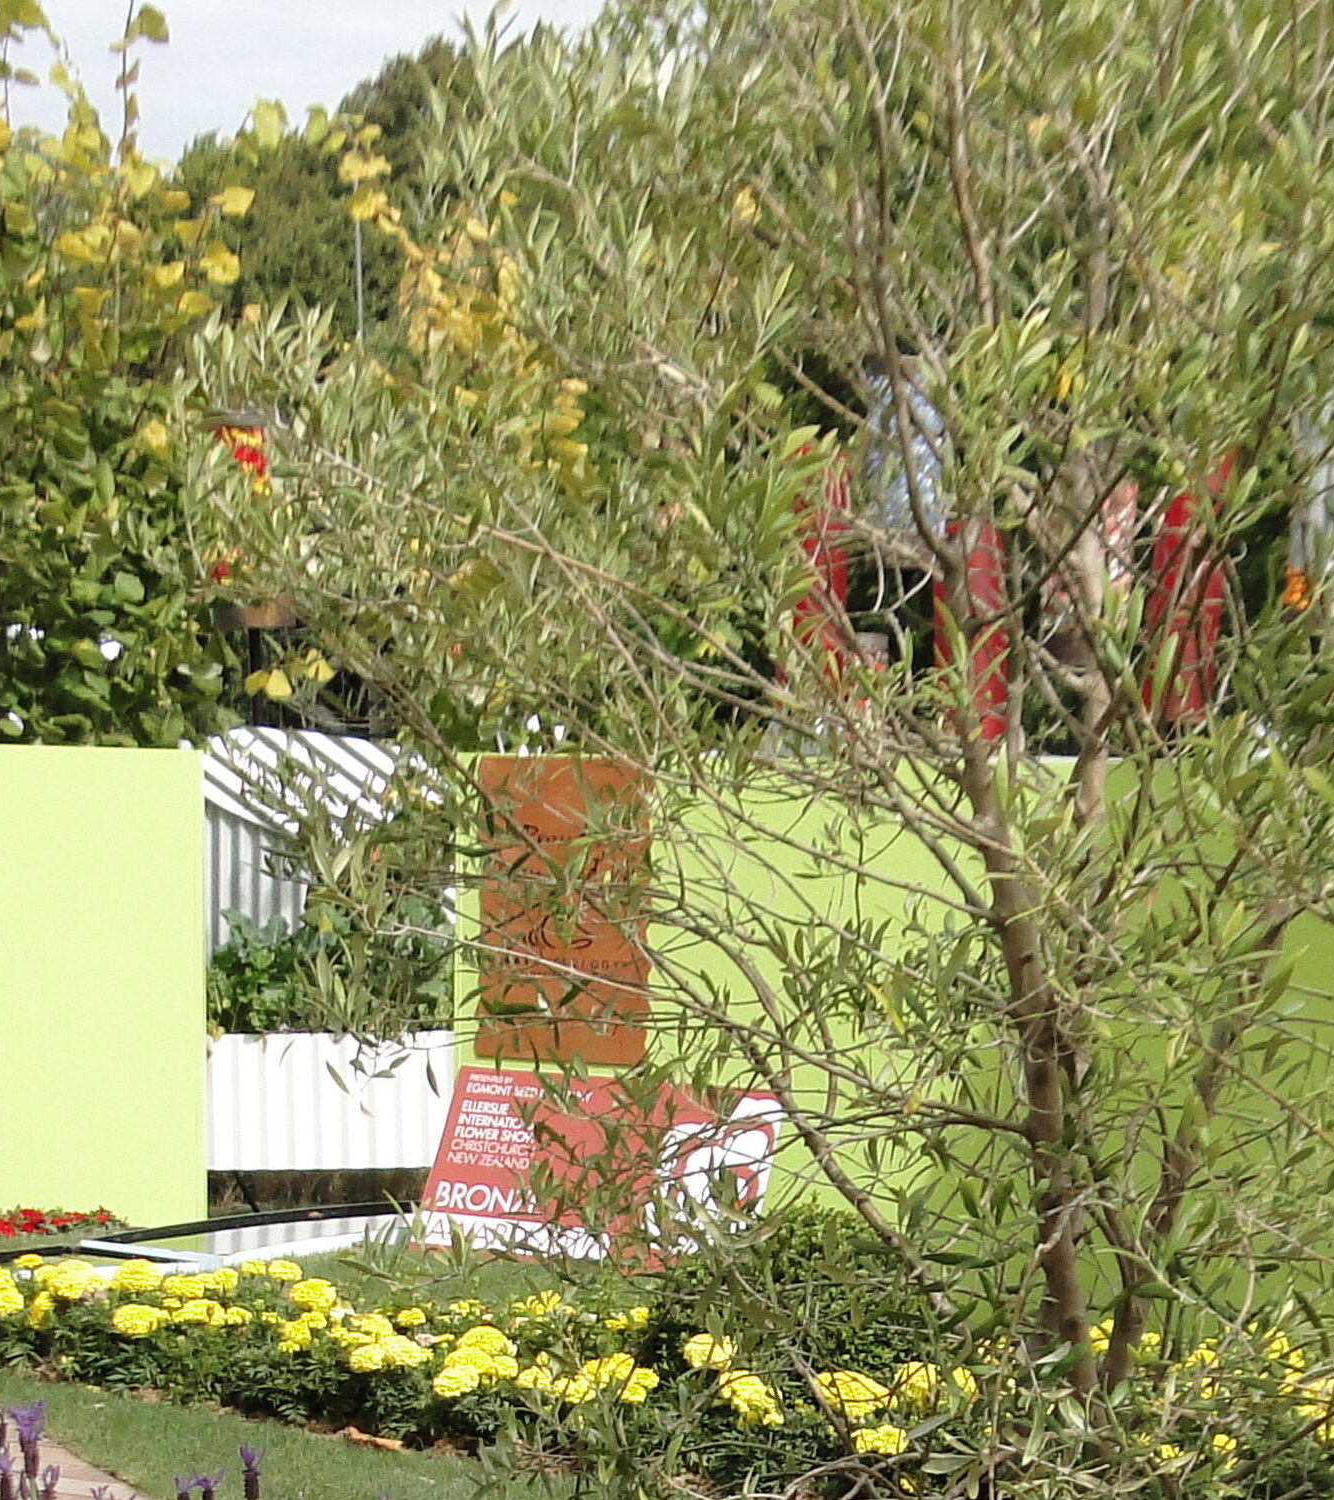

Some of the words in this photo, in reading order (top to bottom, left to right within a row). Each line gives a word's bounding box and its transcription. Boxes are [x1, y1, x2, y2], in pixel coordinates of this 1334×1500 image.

[504, 1076, 514, 1084] BY
[466, 1082, 513, 1097] EGMONT
[462, 1099, 510, 1115] ELLERSLIE
[454, 1126, 500, 1141] FLOWER
[447, 1151, 478, 1166] NEW
[478, 1155, 530, 1170] ZEALAND
